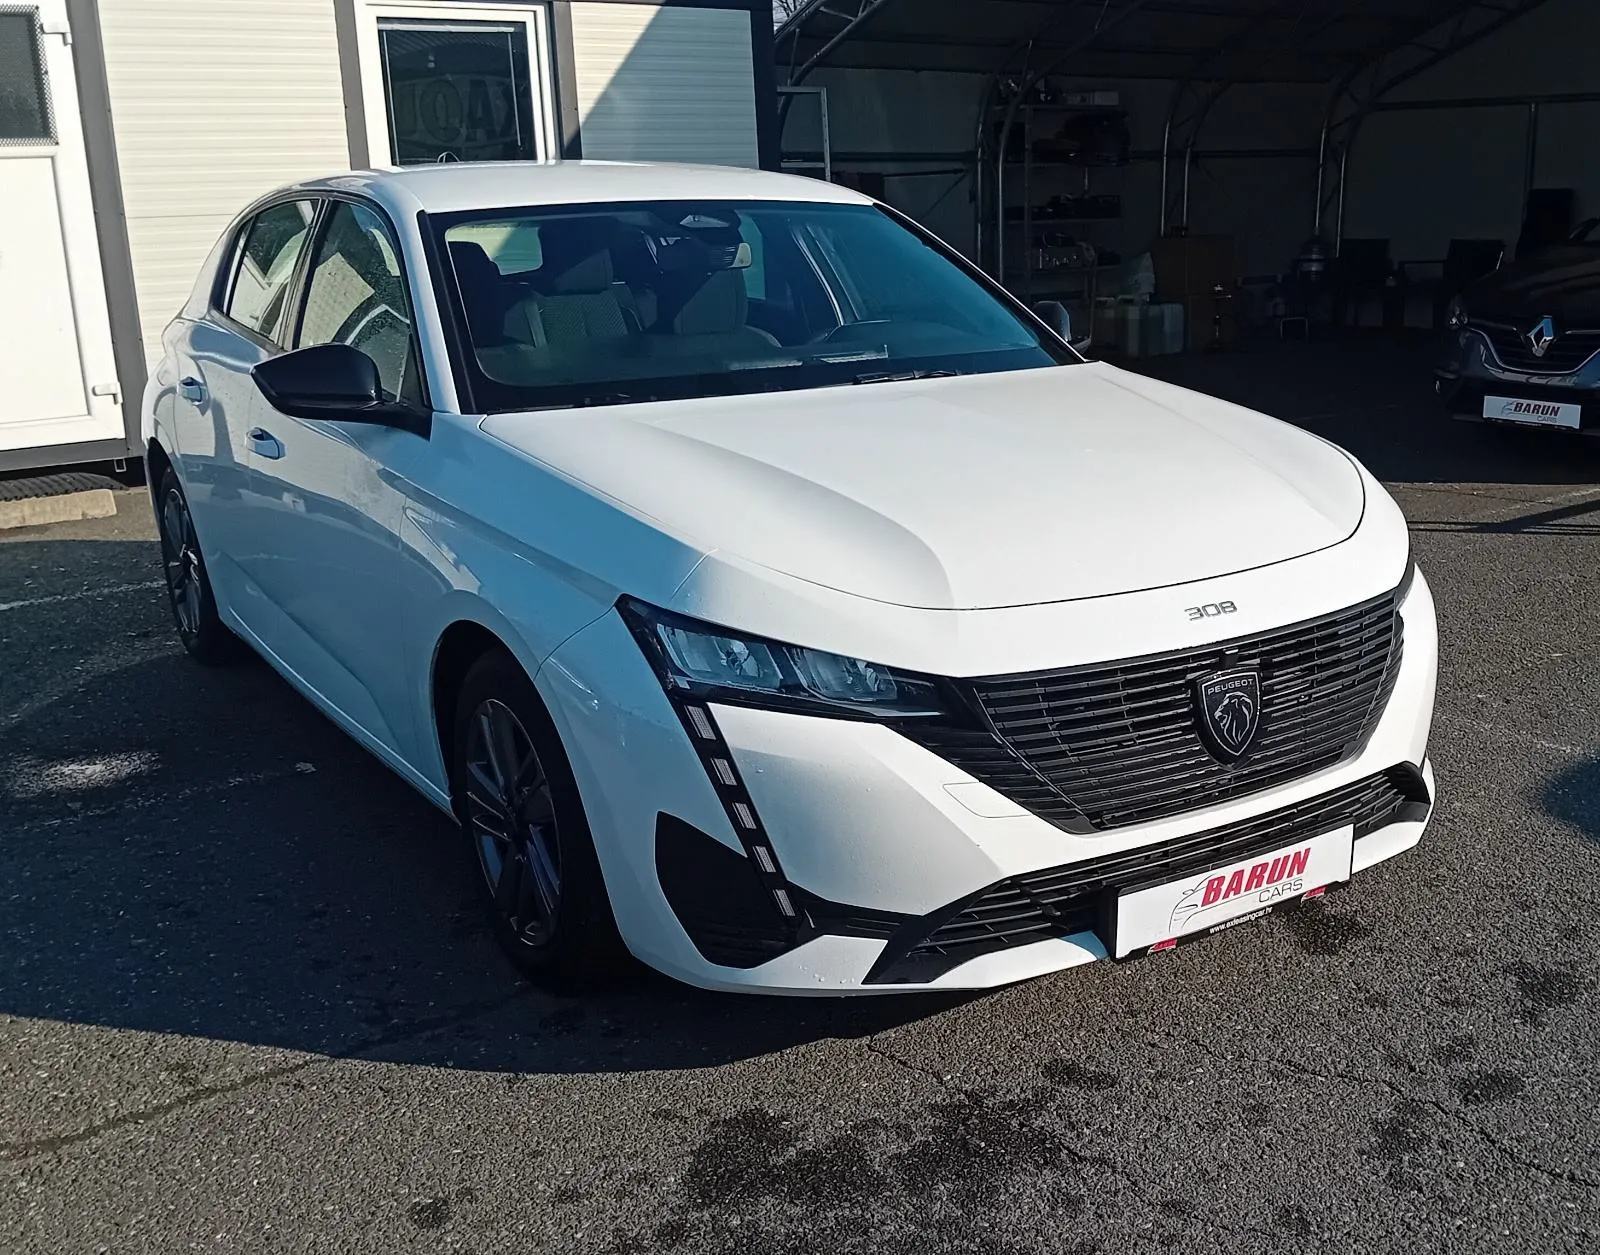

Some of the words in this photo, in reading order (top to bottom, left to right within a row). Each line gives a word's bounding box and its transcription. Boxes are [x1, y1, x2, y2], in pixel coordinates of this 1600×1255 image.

[1513, 402, 1561, 417] BARUN
[1184, 600, 1238, 621] 308
[1207, 678, 1254, 695] PEUGEOT
[1201, 848, 1310, 906] BARUN
[1258, 878, 1303, 904] CARS
